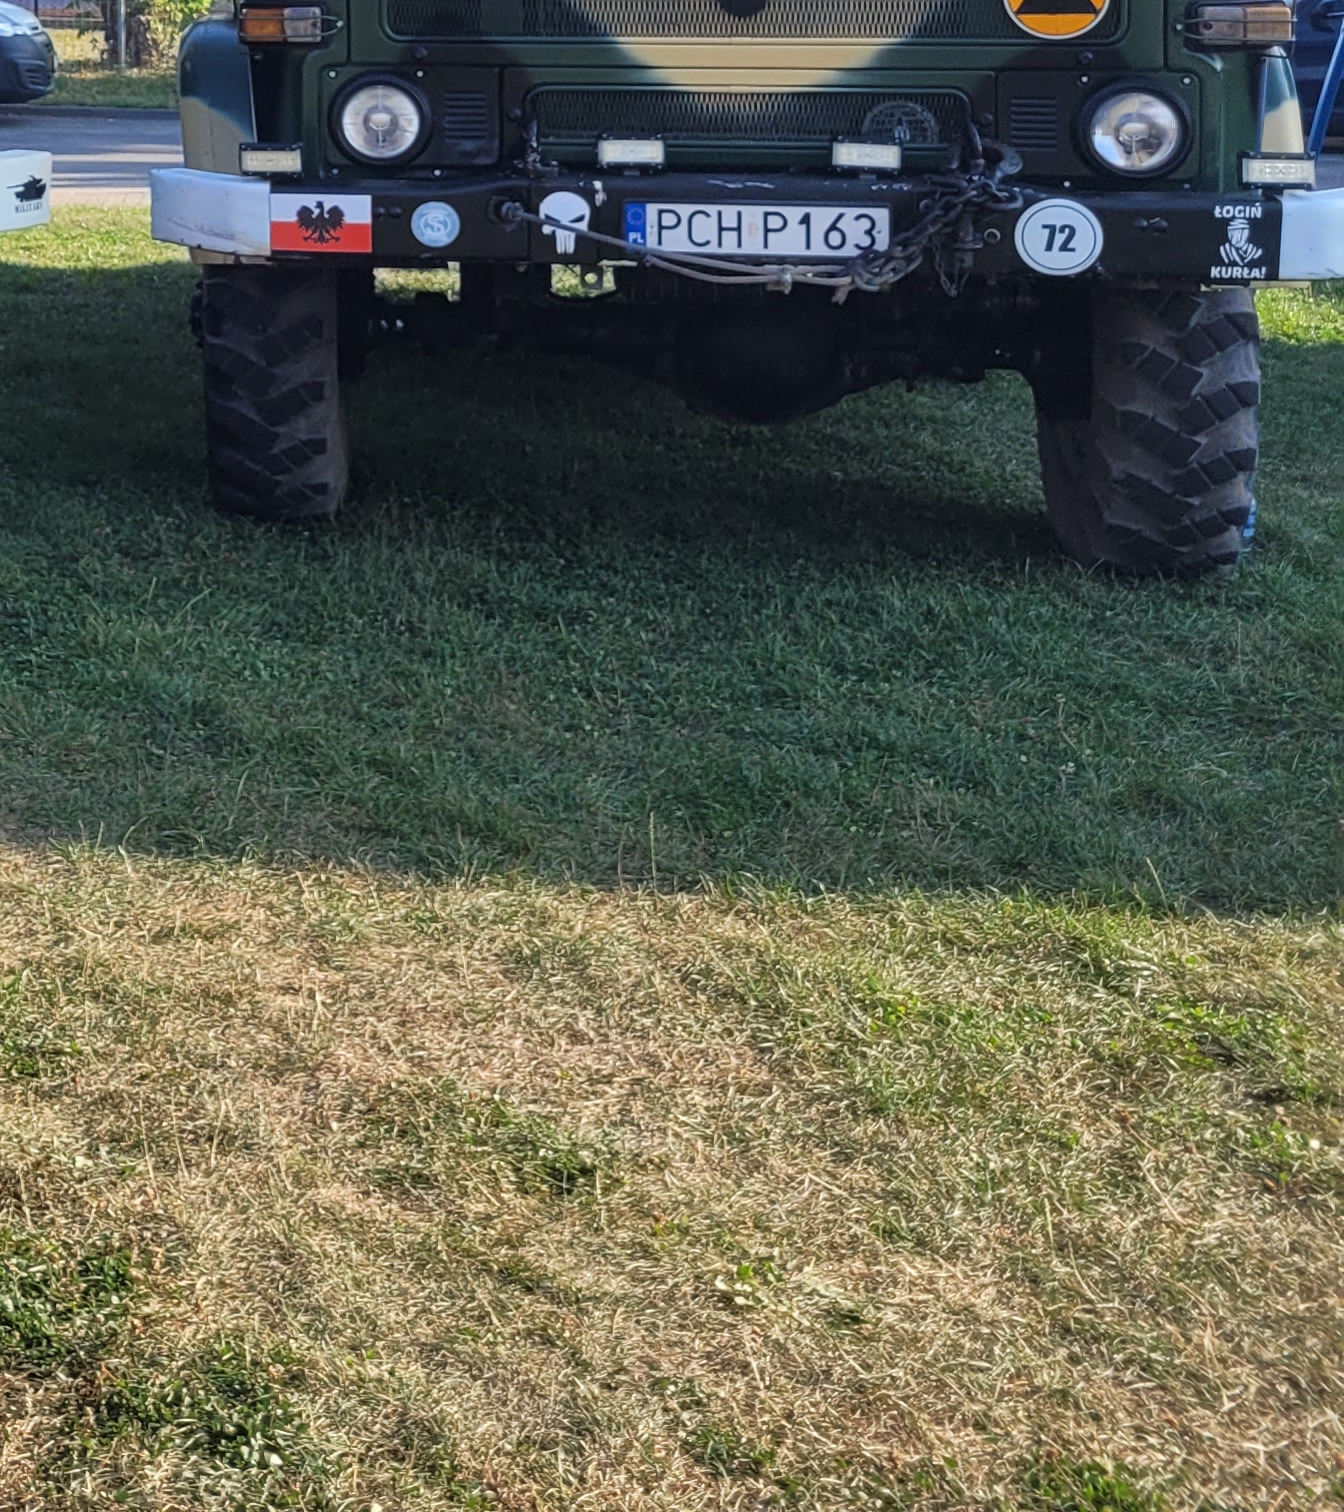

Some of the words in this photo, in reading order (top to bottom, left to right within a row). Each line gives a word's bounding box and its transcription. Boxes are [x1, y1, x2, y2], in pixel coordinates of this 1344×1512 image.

[1213, 202, 1262, 219] ŁOGIŃ
[629, 232, 644, 243] PL
[657, 208, 742, 249] PCH
[762, 211, 877, 251] P163
[1041, 223, 1077, 252] 72
[1210, 266, 1267, 279] KURŁA!
